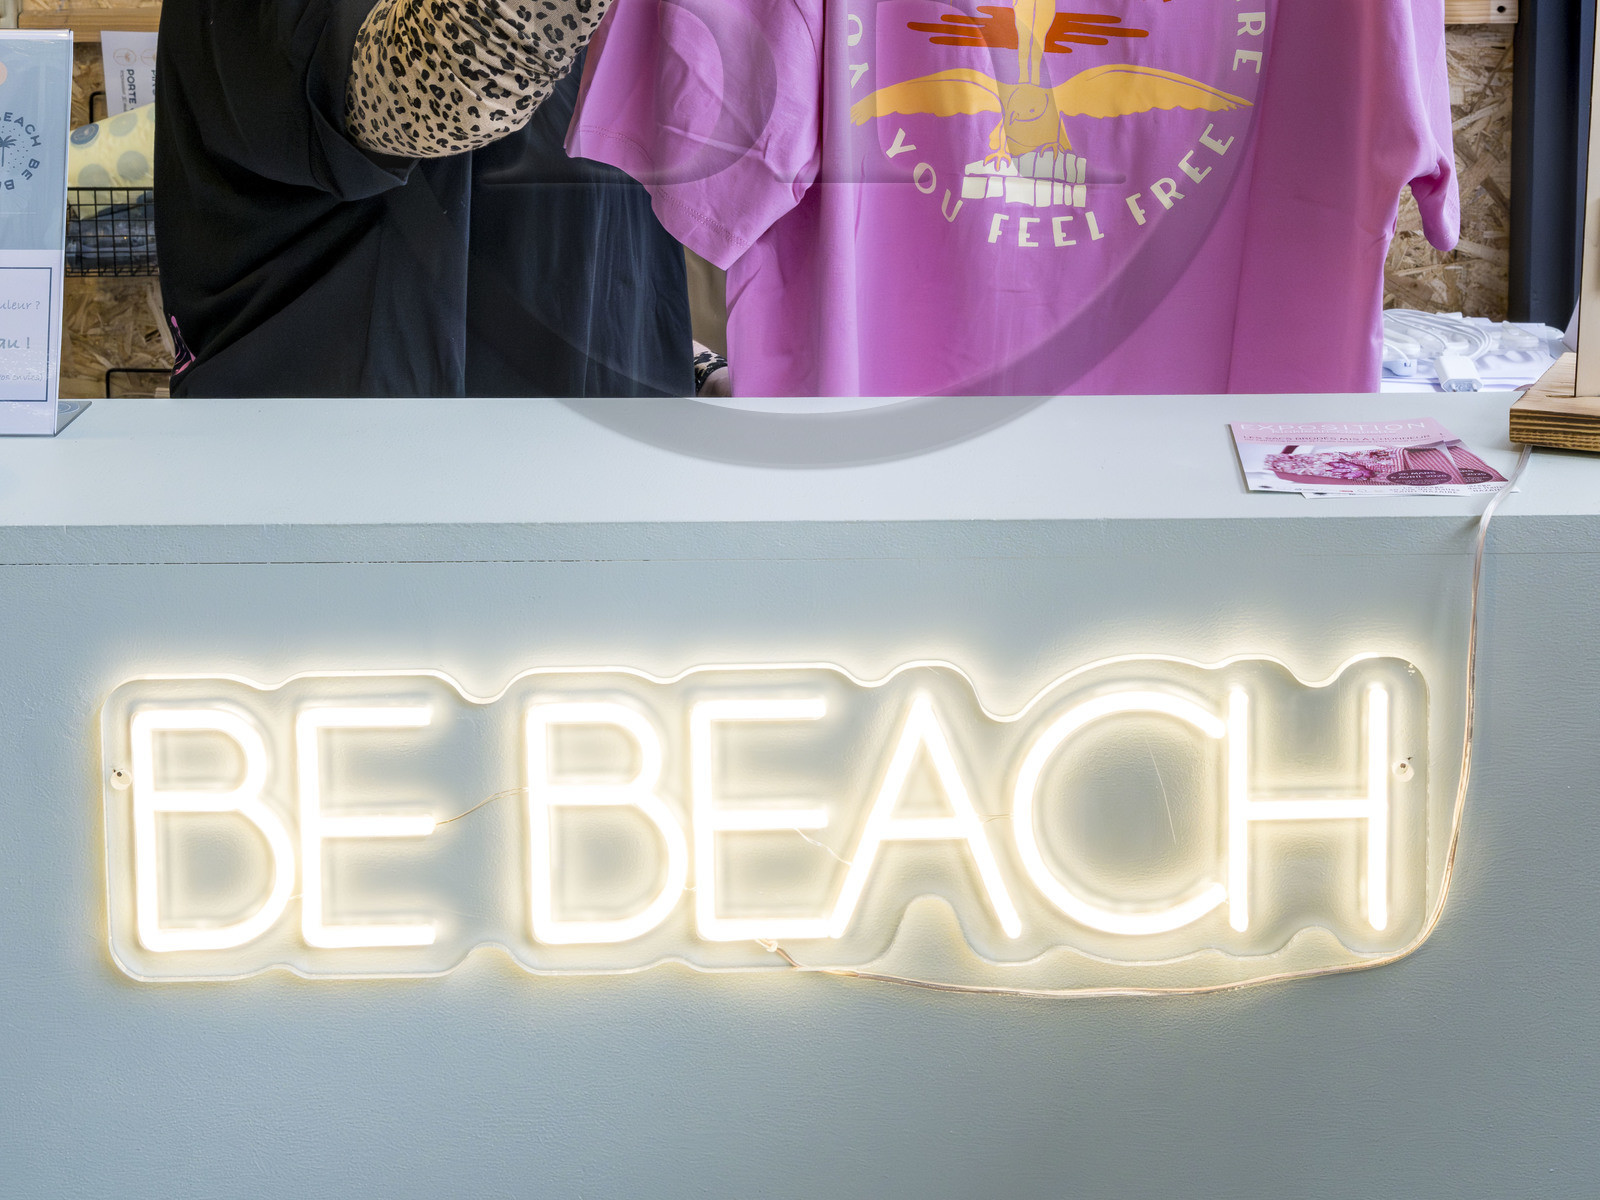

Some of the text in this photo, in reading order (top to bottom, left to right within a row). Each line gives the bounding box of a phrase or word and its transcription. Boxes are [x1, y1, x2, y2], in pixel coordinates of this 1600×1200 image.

[126, 68, 137, 105] PORTE
[0, 111, 42, 147] EACH
[885, 122, 1235, 248] YOU FEEL FREE
[1240, 421, 1426, 432] EXPOSITION
[131, 685, 1389, 953] BE BEACH
